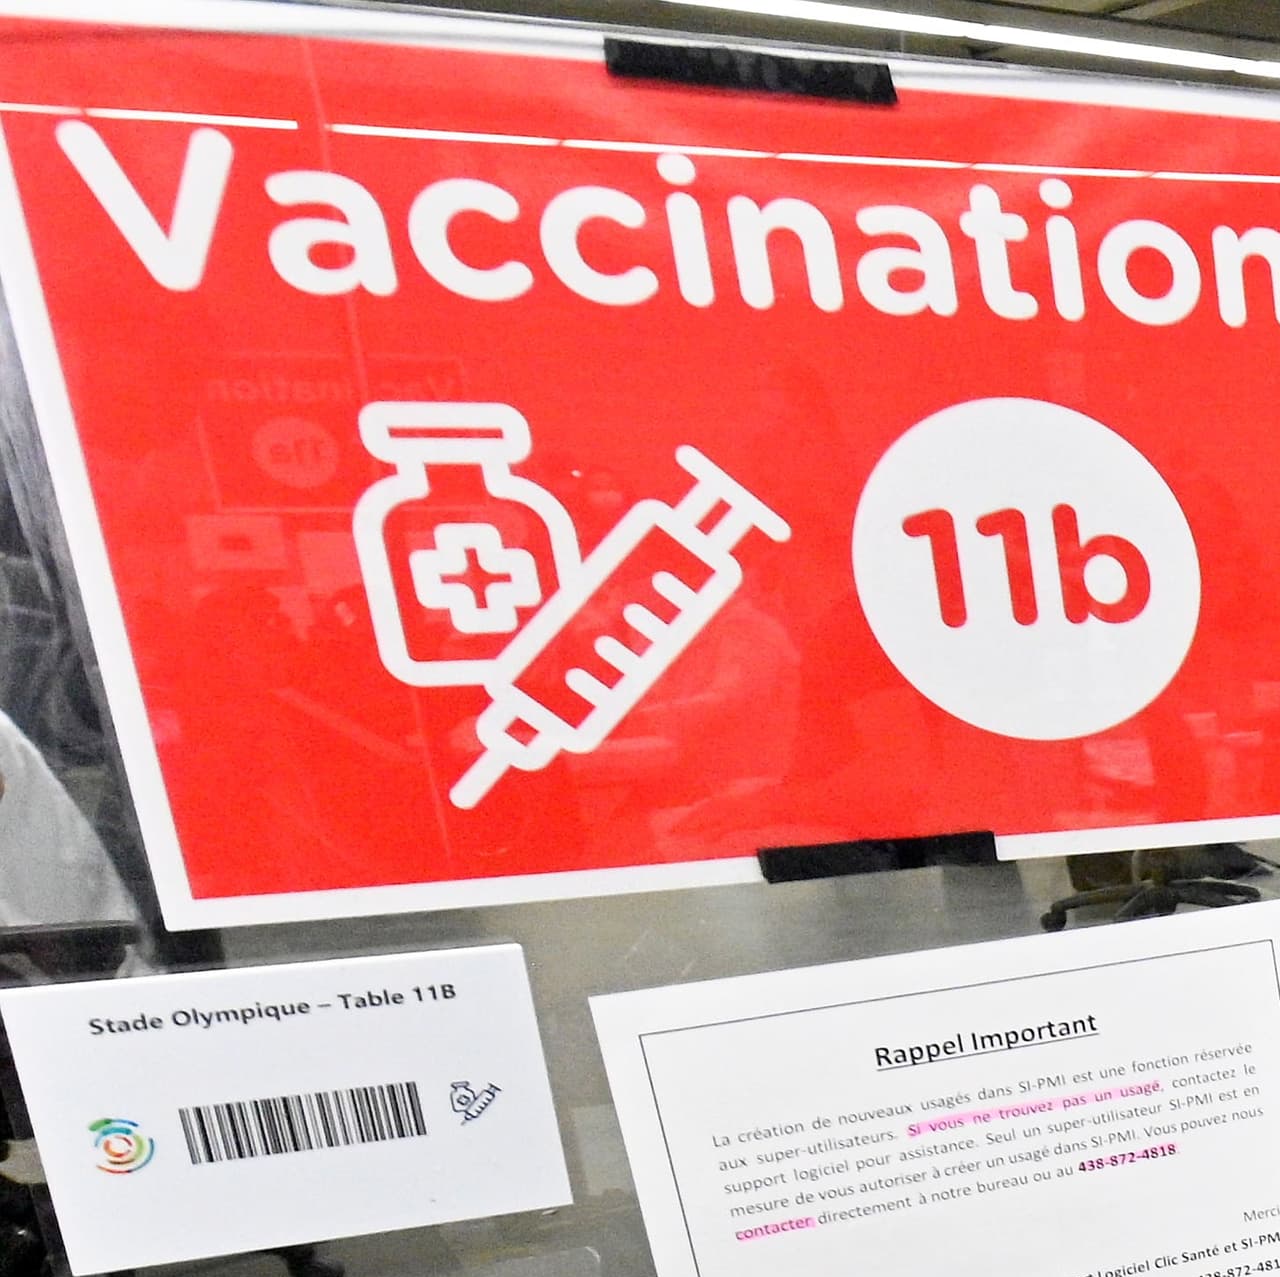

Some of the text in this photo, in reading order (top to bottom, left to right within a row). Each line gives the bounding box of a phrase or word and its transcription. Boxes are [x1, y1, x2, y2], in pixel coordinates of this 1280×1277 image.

[902, 503, 1151, 625] 11b
[89, 1013, 163, 1036] Stade
[172, 1002, 311, 1029] Olympique
[337, 989, 404, 1010] Table
[412, 984, 457, 1002] 11B
[874, 1014, 1098, 1067] Rappel Important
[712, 1042, 1253, 1148] La création de nouveaux usagés dans SI-PMI est une fonction réservée
[719, 1063, 1257, 1172] aux super-utilisateurs. Si vous ne trouvez pas un usagé, contactez le
[724, 1084, 1260, 1195] support logiciel pour assistance. Seul un super-utilisateur SI-PMI est en
[730, 1107, 1264, 1218] mesure de vous autoriser à créer un usagé dans SI-PMI. Vous pouvez nous
[735, 1216, 813, 1241] contacter
[817, 1196, 913, 1225] directement
[918, 1192, 928, 1205] à
[930, 1186, 972, 1202] notre
[977, 1173, 1029, 1193] bureau
[1033, 1170, 1052, 1183] ou
[1056, 1164, 1074, 1177] au
[1154, 1255, 1179, 1270] Clic
[1181, 1246, 1220, 1263] Santé
[1223, 1241, 1238, 1254] et
[1243, 1204, 1280, 1222] Merci
